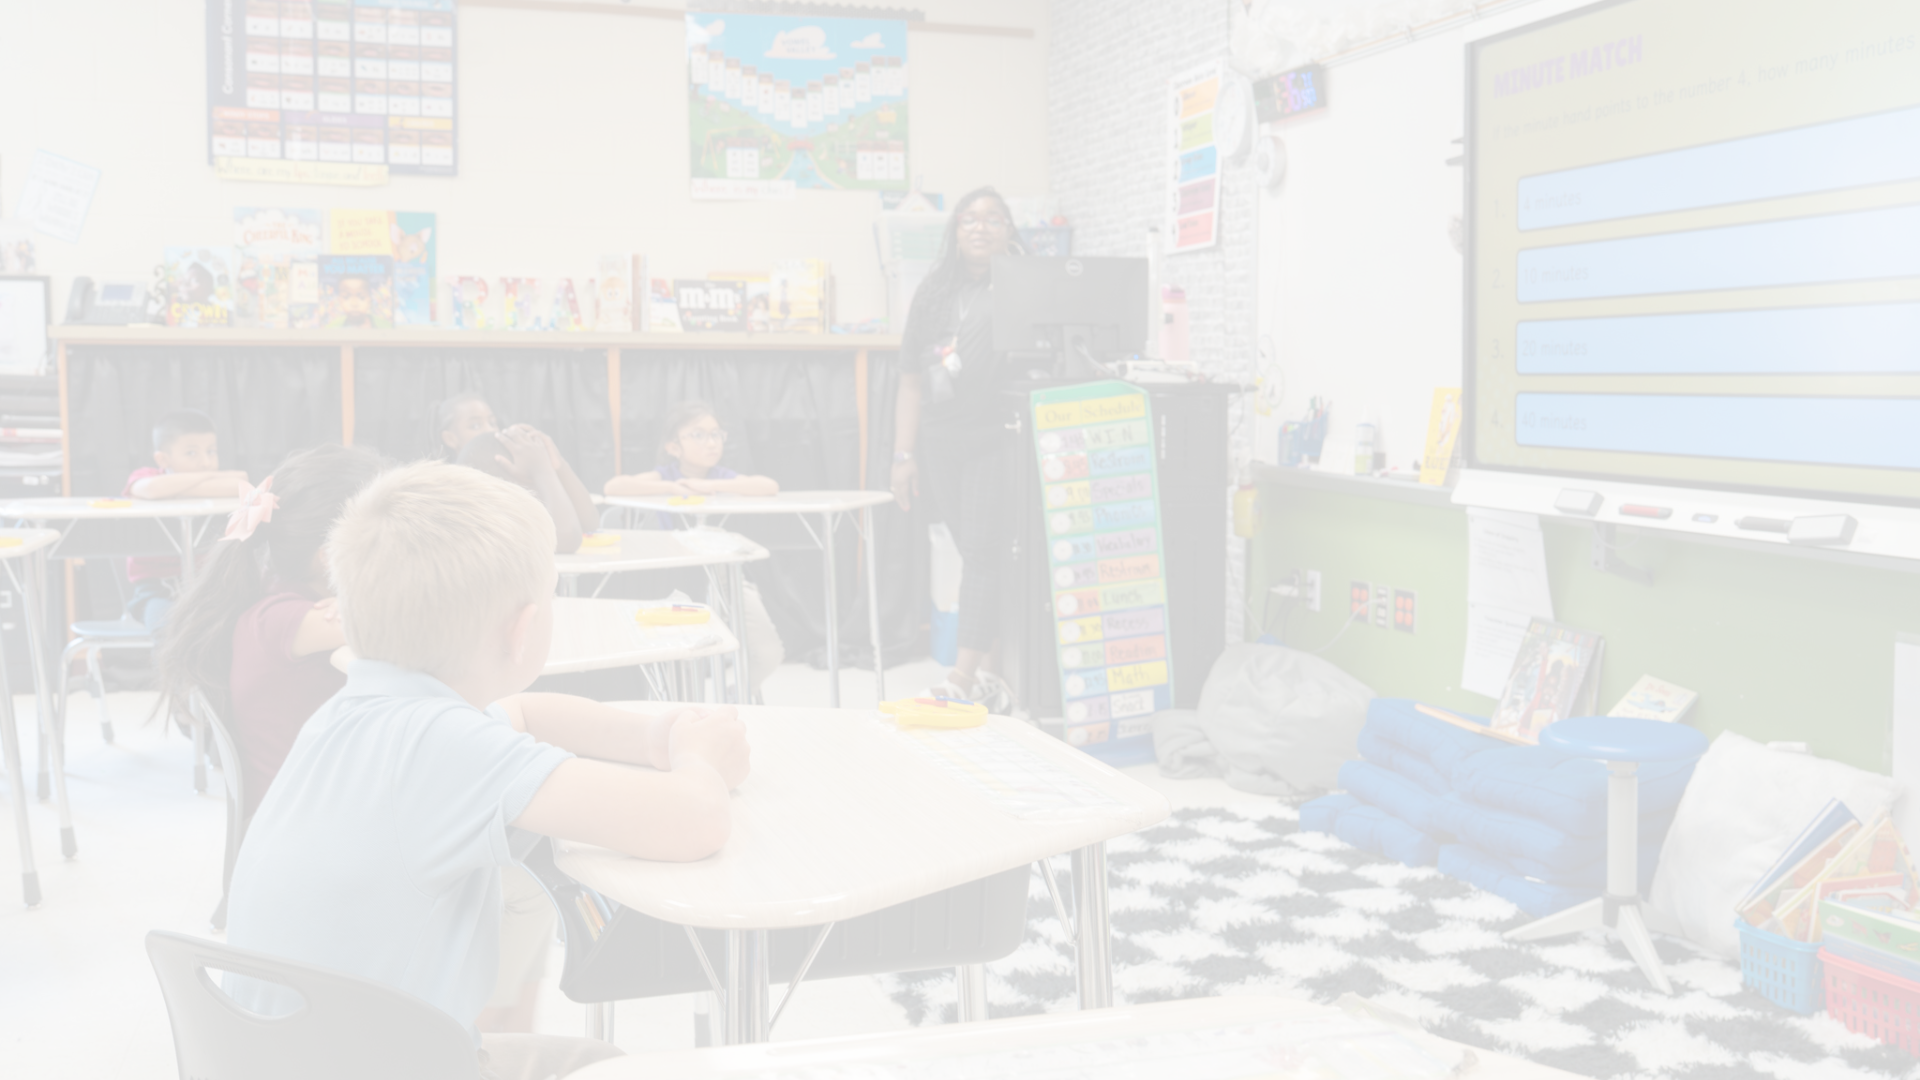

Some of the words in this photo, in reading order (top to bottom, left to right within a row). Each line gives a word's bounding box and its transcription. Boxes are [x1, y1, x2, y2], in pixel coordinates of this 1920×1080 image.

[1493, 56, 1566, 99] MINUTE
[1569, 34, 1643, 80] MATCH
[1493, 126, 1502, 142] If
[1503, 123, 1520, 140] the
[1523, 116, 1559, 137] minute
[1562, 105, 1592, 126] hand
[1595, 99, 1632, 124] points
[1636, 95, 1649, 111] to
[1653, 88, 1675, 109] the
[1679, 74, 1732, 102] number
[1737, 69, 1751, 90] 4,
[1757, 61, 1789, 83] how
[1794, 52, 1840, 77] many
[1844, 33, 1917, 64] minutes
[1493, 199, 1506, 219] 1.
[1523, 201, 1531, 212] 4
[1534, 191, 1582, 211] minutes
[323, 263, 346, 275] YOU
[346, 264, 386, 275] MATTER
[1491, 268, 1505, 289] 2.
[1523, 267, 1537, 285] 10
[1541, 265, 1590, 284] minutes
[170, 301, 228, 320] CROWN
[1490, 338, 1505, 359] 3.
[1521, 339, 1537, 357] 20
[1540, 340, 1588, 357] minutes
[1045, 410, 1073, 424] Our
[1083, 400, 1142, 420] Schedule
[1490, 410, 1504, 429] 4.
[1521, 411, 1536, 428] 40
[1540, 413, 1587, 431] minutes
[1092, 452, 1145, 470] Restroom
[1092, 477, 1144, 500] Specials
[1095, 504, 1147, 525] Phonics
[1100, 560, 1150, 578] Restroom
[1103, 587, 1143, 606] Lunch
[1106, 616, 1149, 632] Recess
[1112, 666, 1150, 686] Math
